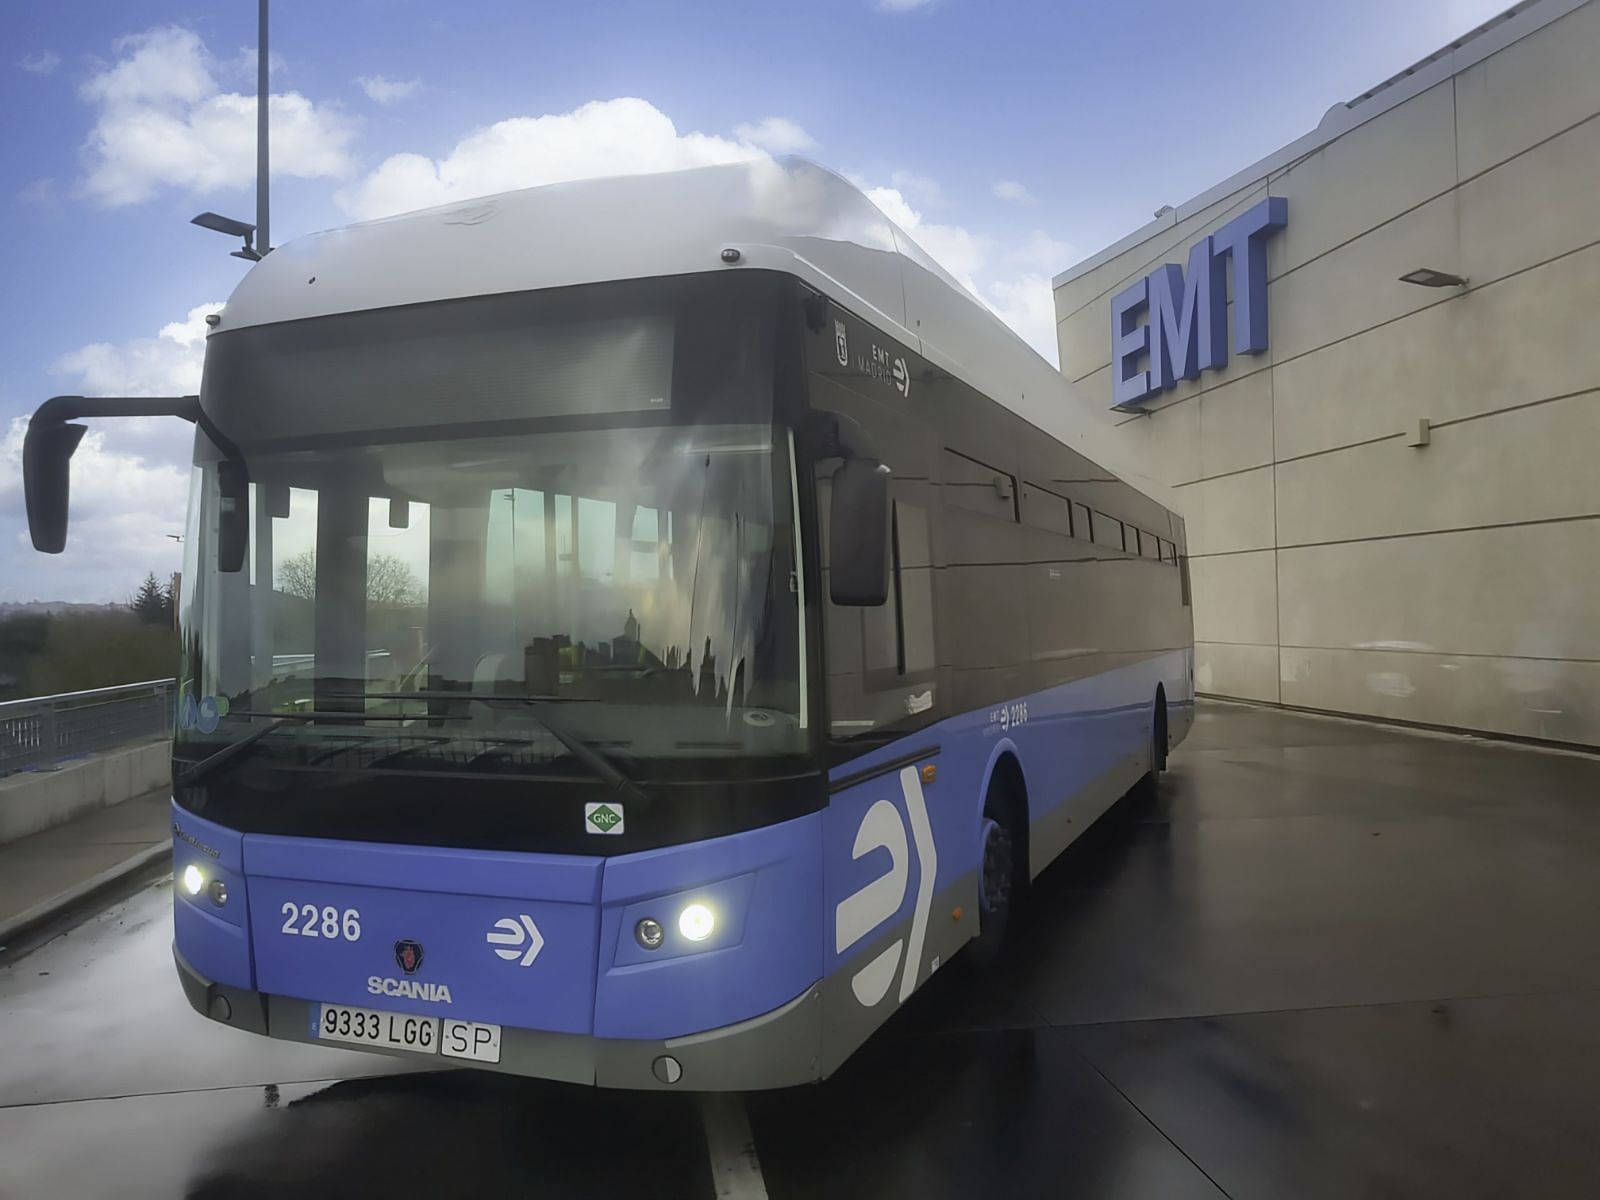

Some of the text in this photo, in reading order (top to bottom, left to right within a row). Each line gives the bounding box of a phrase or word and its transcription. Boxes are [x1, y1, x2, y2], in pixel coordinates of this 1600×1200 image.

[1111, 196, 1288, 408] EMT
[872, 343, 890, 368] EMT
[593, 813, 616, 824] GNC
[281, 902, 361, 942] 2286
[367, 975, 453, 1004] SCANIA
[325, 1008, 432, 1047] 9333 LGG
[451, 1025, 492, 1056] SP
